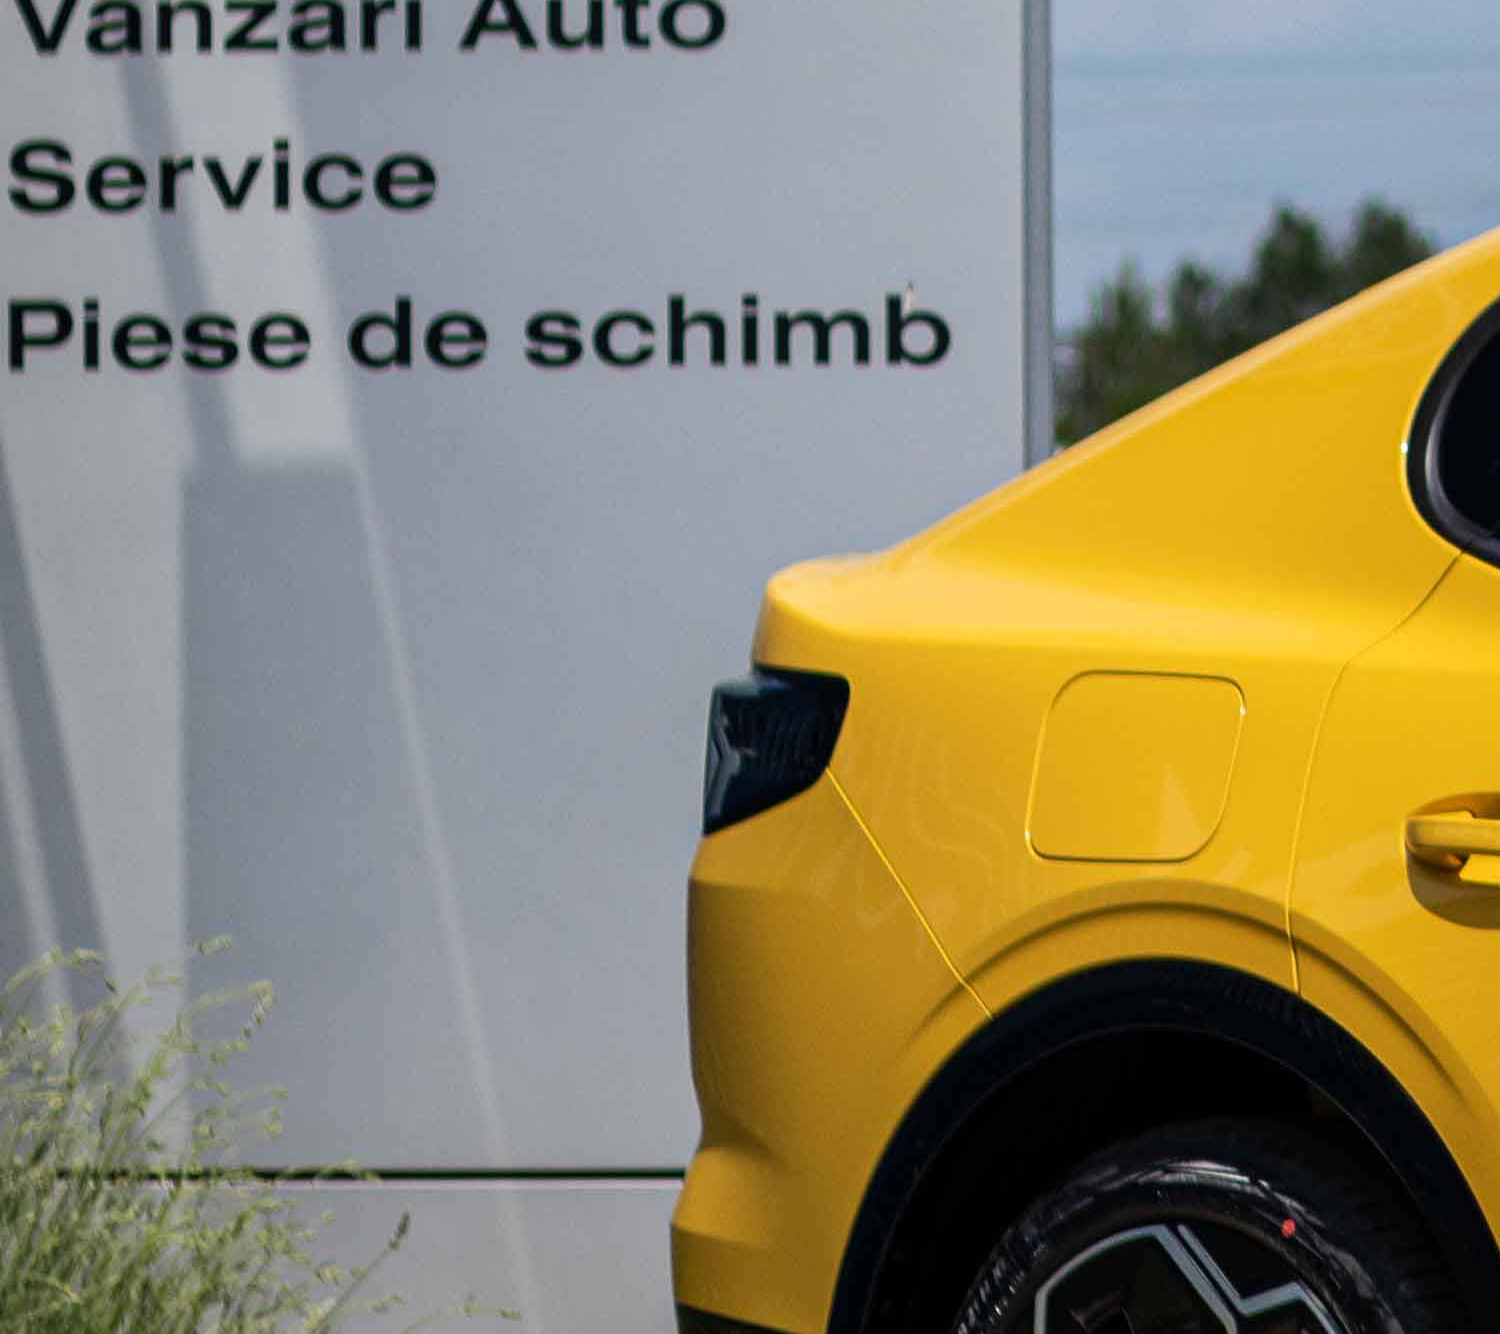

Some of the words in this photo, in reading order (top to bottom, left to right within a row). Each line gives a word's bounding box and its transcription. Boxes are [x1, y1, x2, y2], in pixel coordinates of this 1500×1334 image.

[7, 139, 438, 214] Service
[7, 296, 310, 373] Piese
[348, 295, 487, 371] de
[524, 292, 952, 369] schimb
